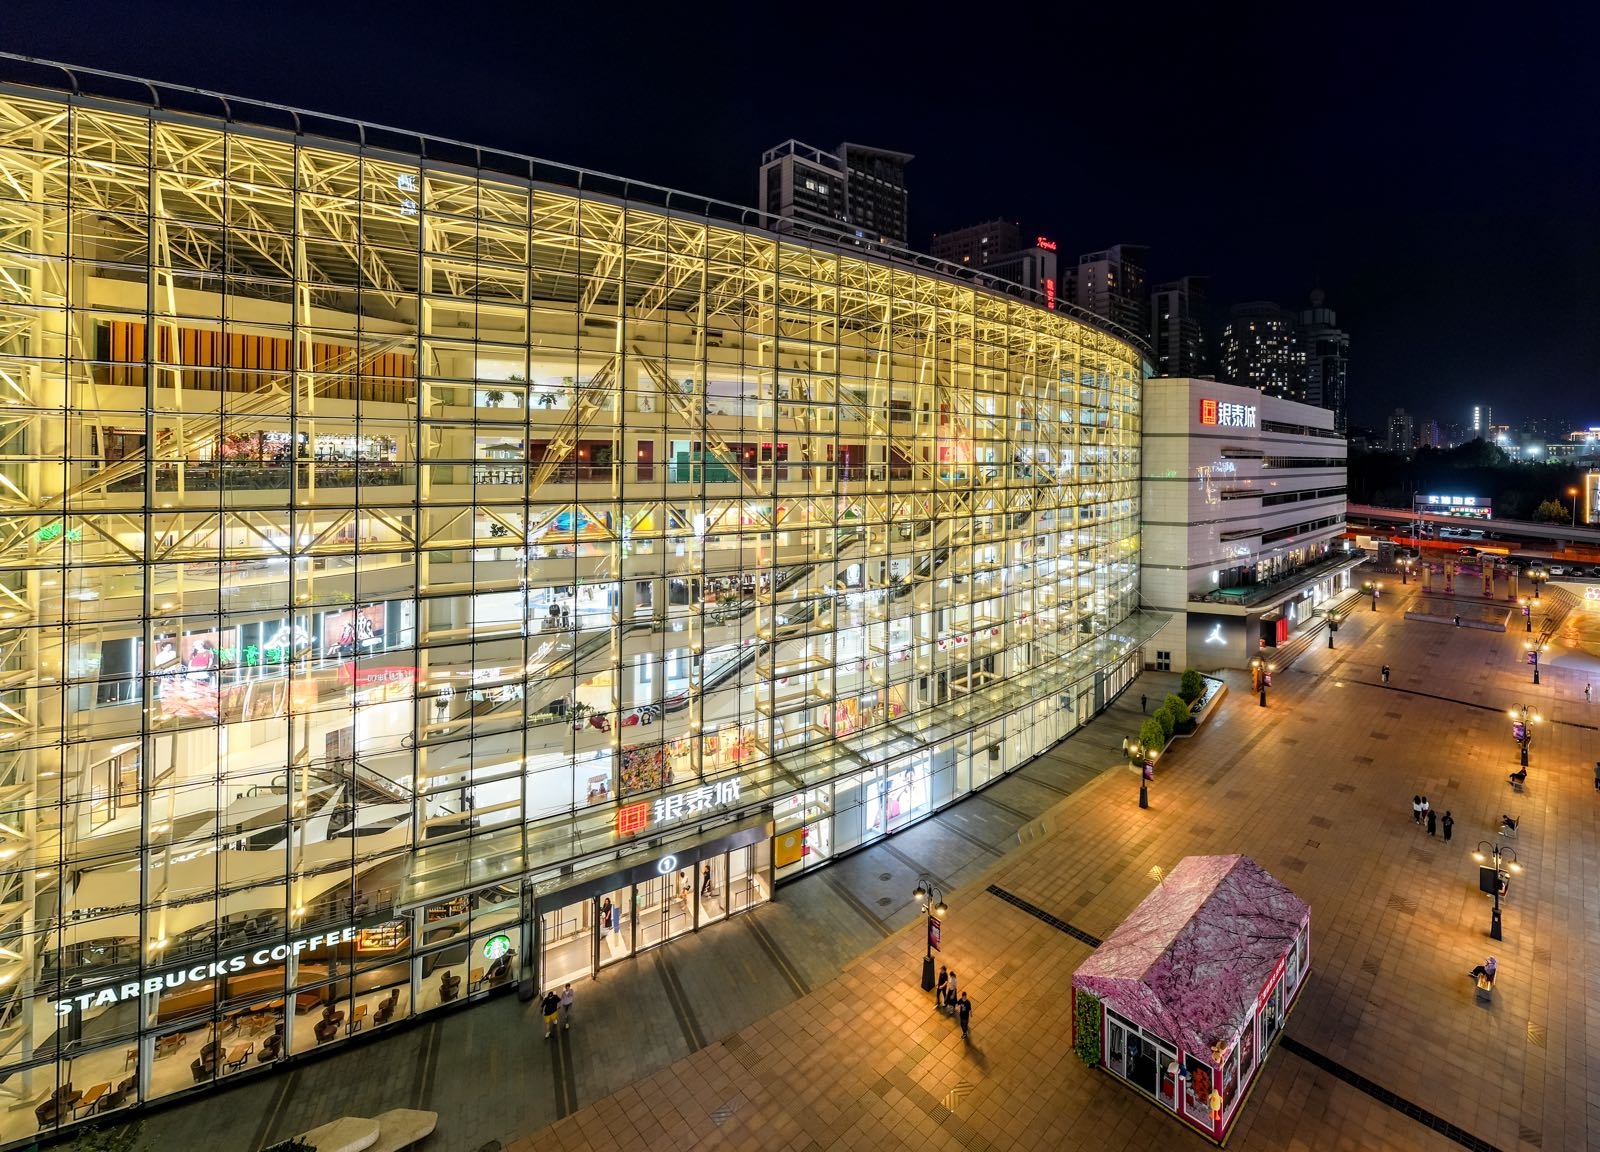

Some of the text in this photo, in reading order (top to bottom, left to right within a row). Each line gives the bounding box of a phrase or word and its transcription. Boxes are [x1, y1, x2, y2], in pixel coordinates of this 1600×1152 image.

[1217, 401, 1257, 428] 银泰城
[653, 776, 742, 824] 银泰城
[54, 926, 358, 1017] STARBUCKS COFFEE
